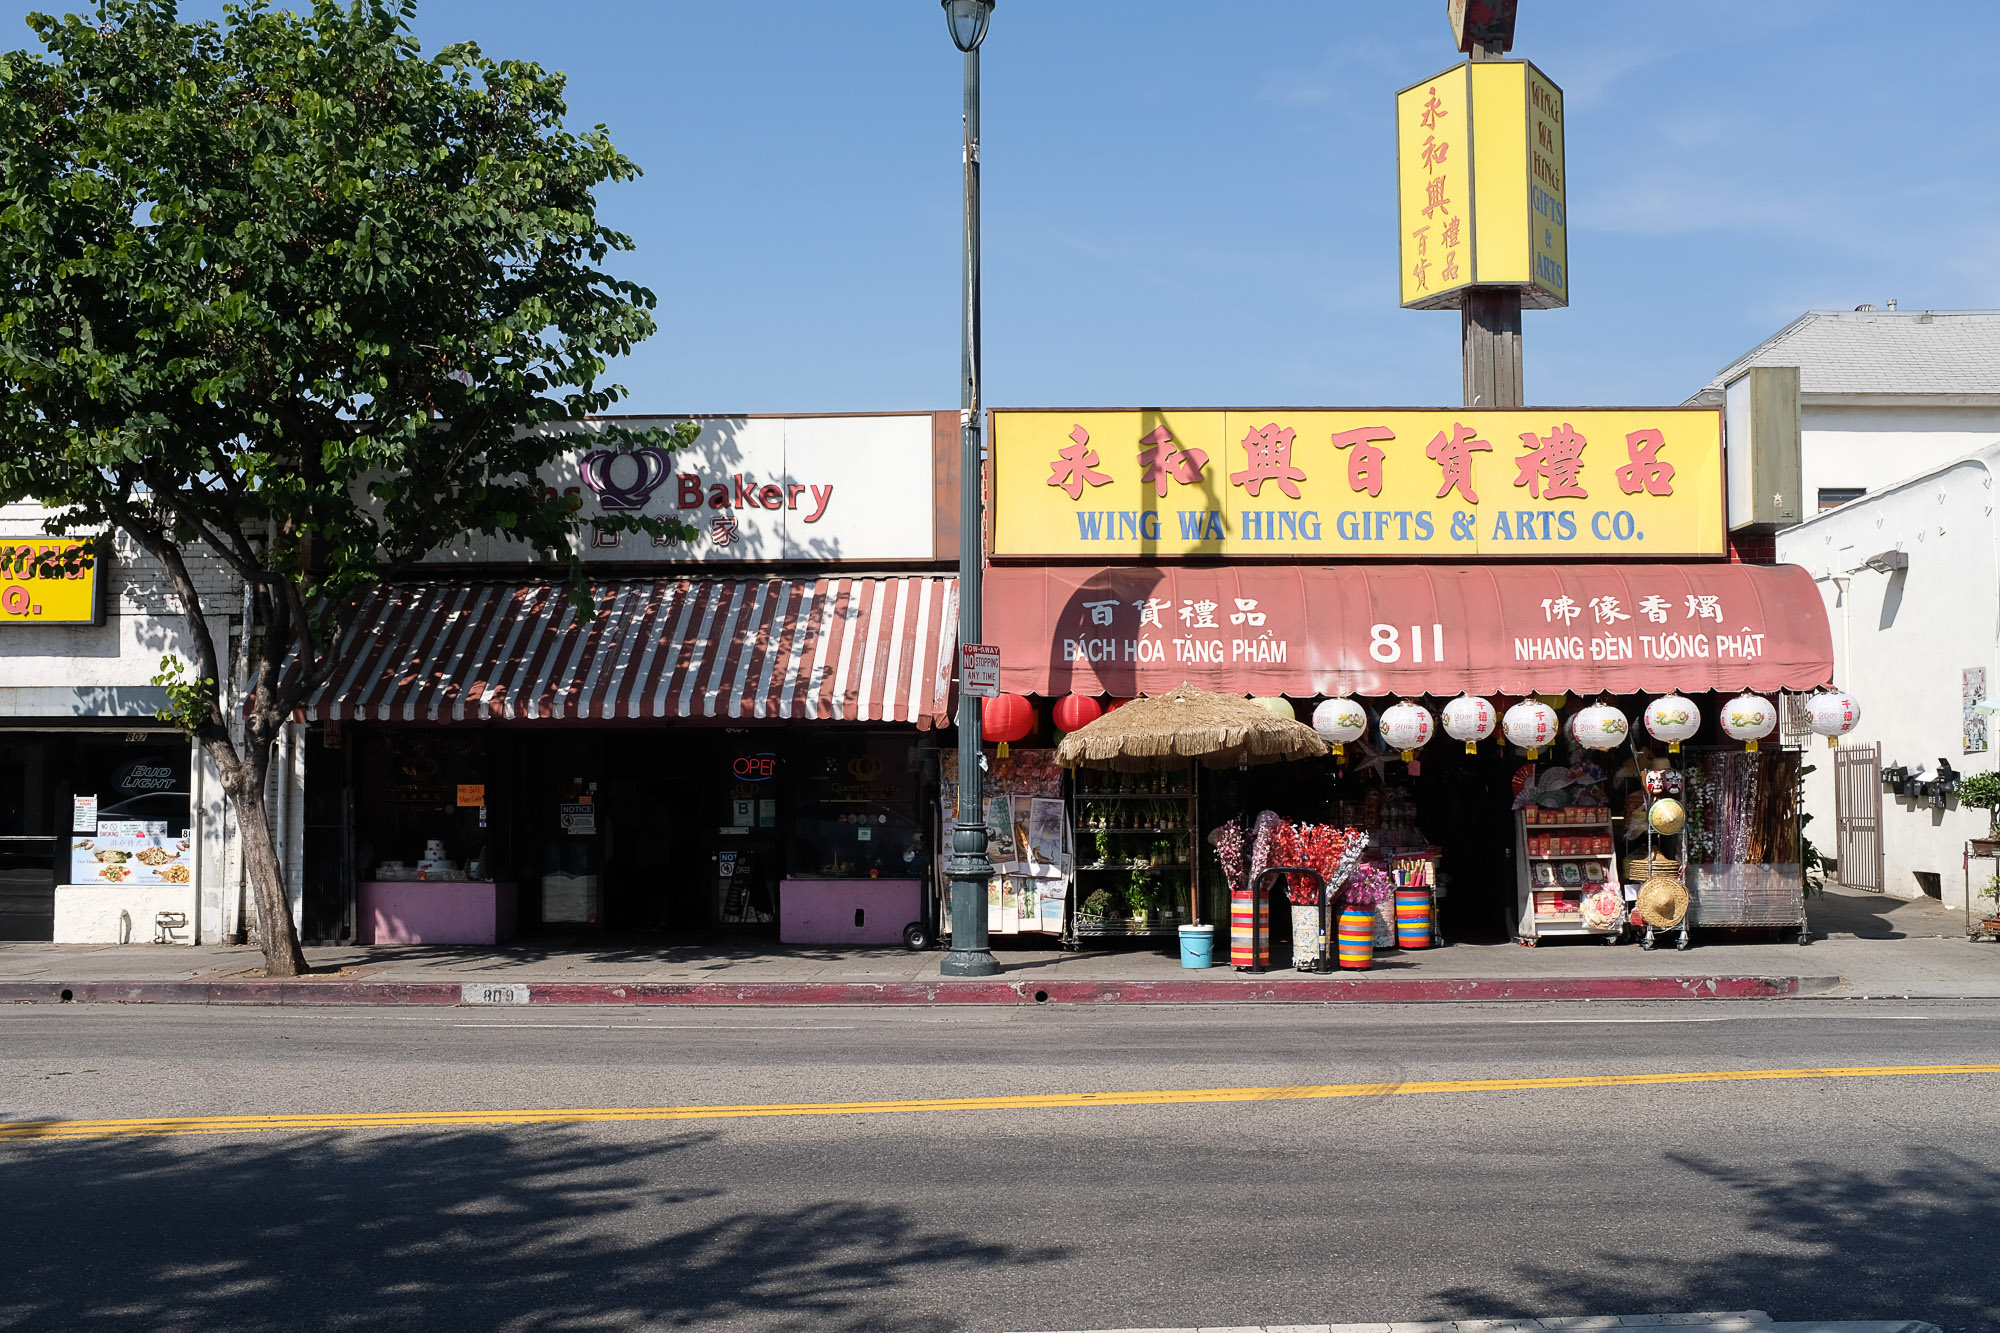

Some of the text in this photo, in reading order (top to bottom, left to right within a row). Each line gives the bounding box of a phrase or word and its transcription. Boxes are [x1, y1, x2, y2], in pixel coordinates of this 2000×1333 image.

[1531, 80, 1559, 123] WING
[1420, 86, 1450, 220] 永和興
[1537, 121, 1553, 154] WA
[1533, 150, 1559, 191] HING
[1532, 184, 1563, 227] GIFTS
[1545, 227, 1552, 249] &
[1536, 250, 1563, 289] ARTS
[1047, 422, 1676, 505] 永和興百貨禮品
[676, 473, 833, 523] Bakery
[1076, 510, 1645, 541] WING WA HING GIFTS & ARTS CO.
[2, 585, 42, 618] Q.
[1082, 598, 1267, 629] 百貨禮品
[1540, 594, 1724, 626] 佛像香燭
[964, 644, 999, 655] TOW-AWAY
[1063, 629, 1288, 666] BÁCH HÓA TẶNG PHẨM
[1369, 623, 1444, 663] 811
[1514, 626, 1765, 662] NHANG ĐÈN TƯỢNG PHẬT
[964, 654, 998, 669] NO STOPPING
[967, 671, 996, 681] ANY TIME
[126, 732, 147, 741] 807
[121, 776, 176, 789] LIGHT
[131, 765, 171, 778] BUD
[562, 805, 593, 814] NOTICE
[738, 802, 749, 815] B
[483, 989, 514, 1002] 809
